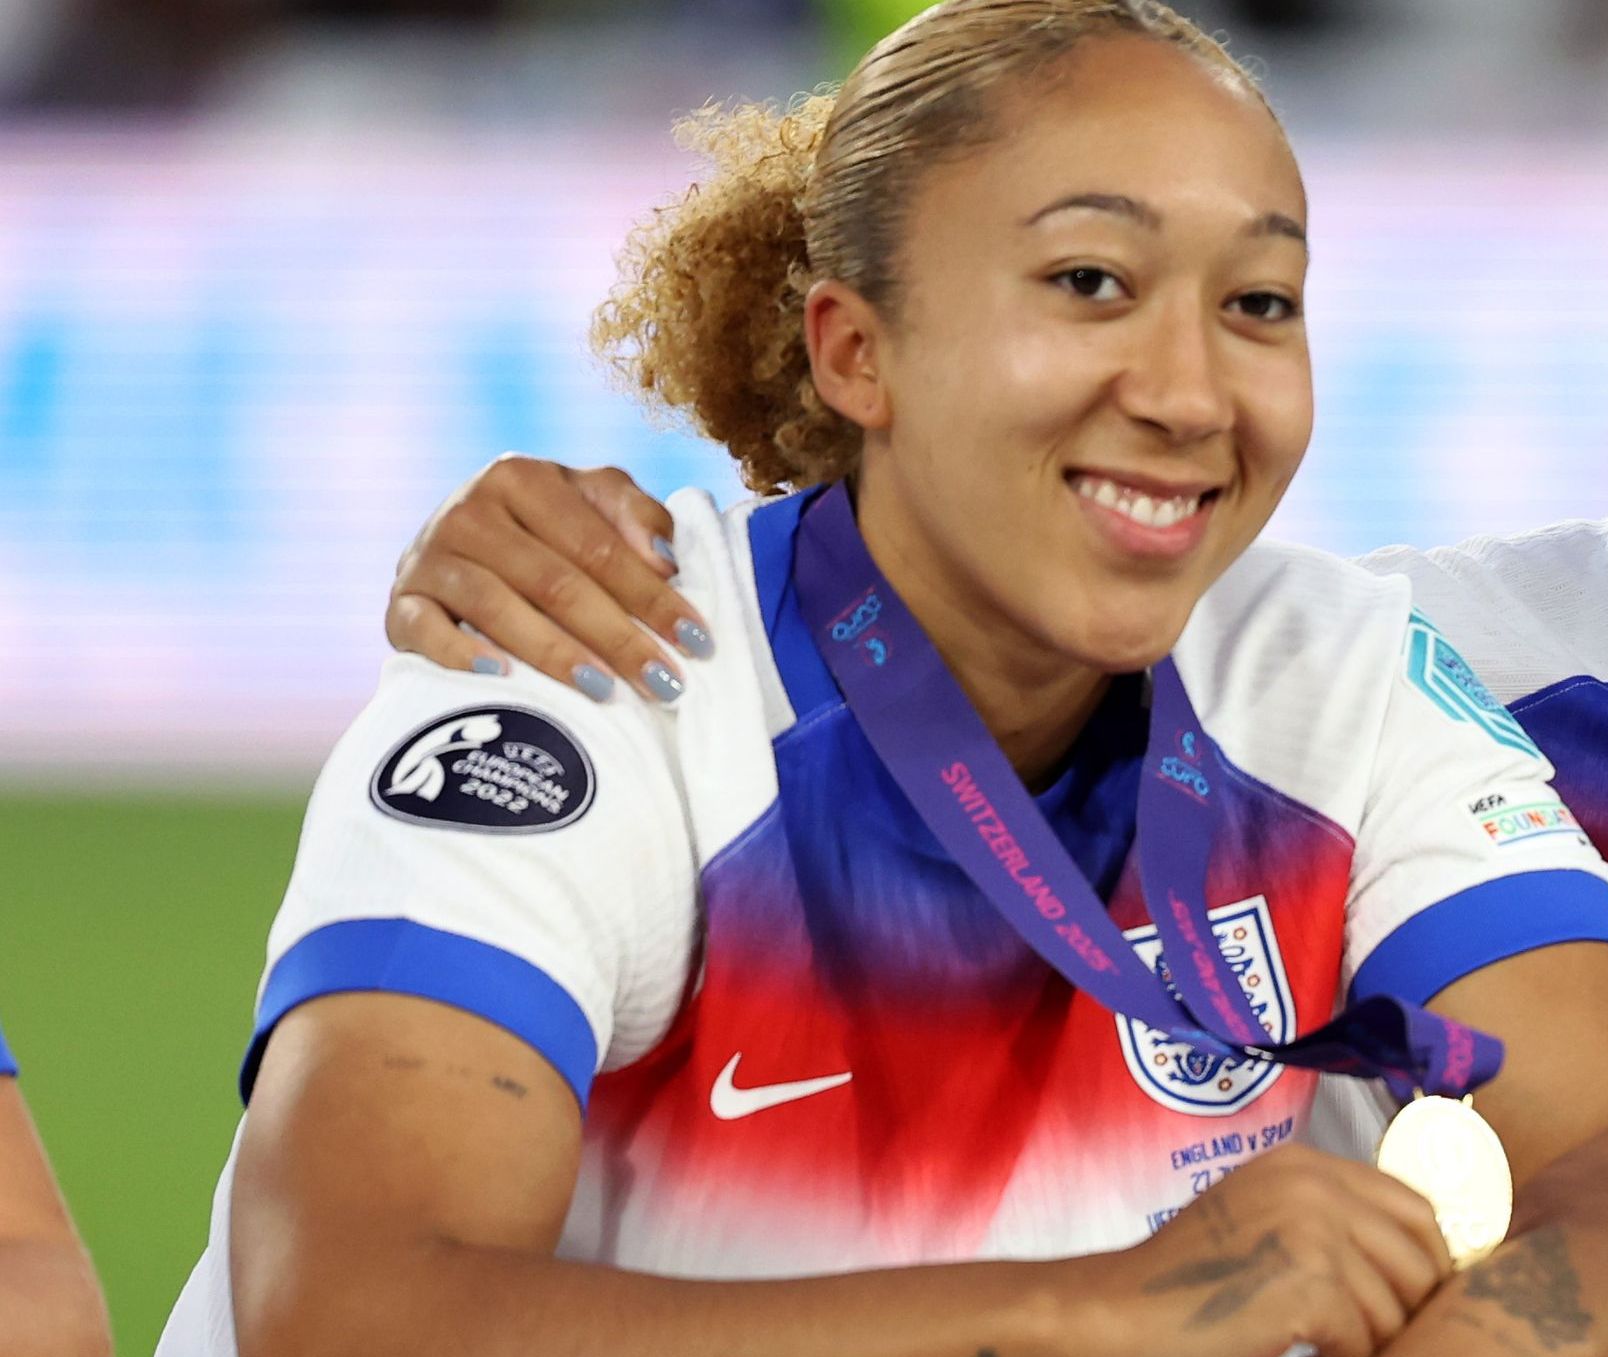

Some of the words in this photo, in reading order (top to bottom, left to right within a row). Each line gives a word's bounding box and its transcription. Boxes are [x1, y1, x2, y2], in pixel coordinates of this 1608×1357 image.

[459, 778, 530, 815] 2022
[941, 762, 1067, 921] SWITZERLAND
[1171, 1133, 1243, 1170] ENGLAND
[1261, 1116, 1294, 1148] SPAIN
